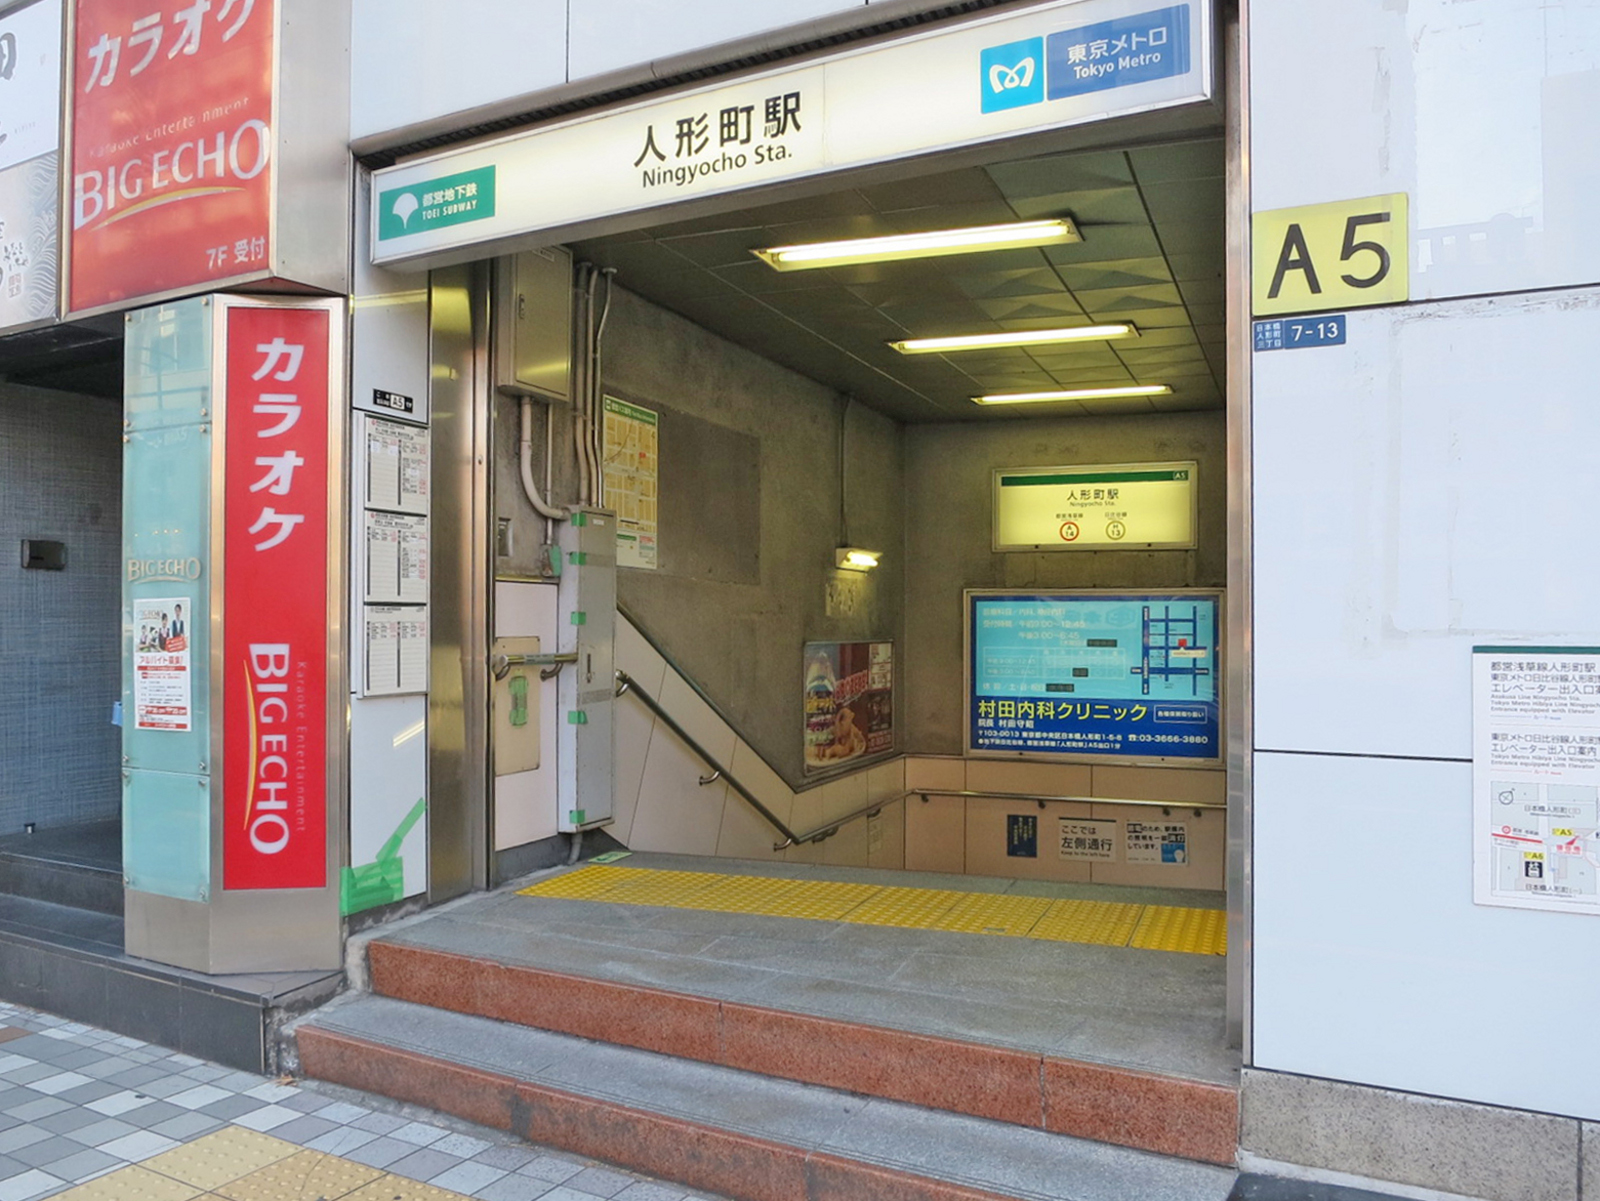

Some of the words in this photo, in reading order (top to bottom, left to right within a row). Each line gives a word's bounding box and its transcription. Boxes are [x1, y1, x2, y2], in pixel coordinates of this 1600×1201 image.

[1067, 26, 1167, 65] 東京メトロ
[1073, 60, 1115, 80] Tokyo
[1118, 50, 1162, 71] Metro
[634, 91, 802, 168] 人形町駅
[74, 158, 143, 231] BIG
[151, 118, 271, 190] ECHO
[642, 152, 747, 188] Ningyocho
[754, 142, 793, 165] Sta.
[422, 181, 478, 208] 都営地下鉄
[421, 207, 441, 221] TOEI
[442, 199, 479, 218] SUBWAY
[206, 246, 228, 270] 7F
[233, 235, 266, 264] 受付
[1267, 212, 1392, 299] A5
[1291, 322, 1338, 342] 7-13
[248, 337, 305, 551] カラオケ
[1067, 488, 1119, 500] 人形町駅
[127, 559, 156, 582] BIG
[157, 556, 201, 580] ECHO
[1491, 662, 1596, 672] 都営浅草線人形町駅
[1491, 673, 1600, 683] 東京メトロ日比谷線人形町
[248, 643, 290, 723] BIG
[296, 661, 307, 717] Karaoke
[978, 699, 1148, 722] 村田内科クリニック
[1491, 733, 1600, 744] 東京メトロ日比谷線人形町
[1491, 743, 1597, 756] エレベーター出入口案内
[296, 727, 307, 832] Entertainment
[250, 734, 290, 855] ECHO
[1061, 825, 1096, 835] ここでは
[1061, 836, 1113, 851] 左側通行
